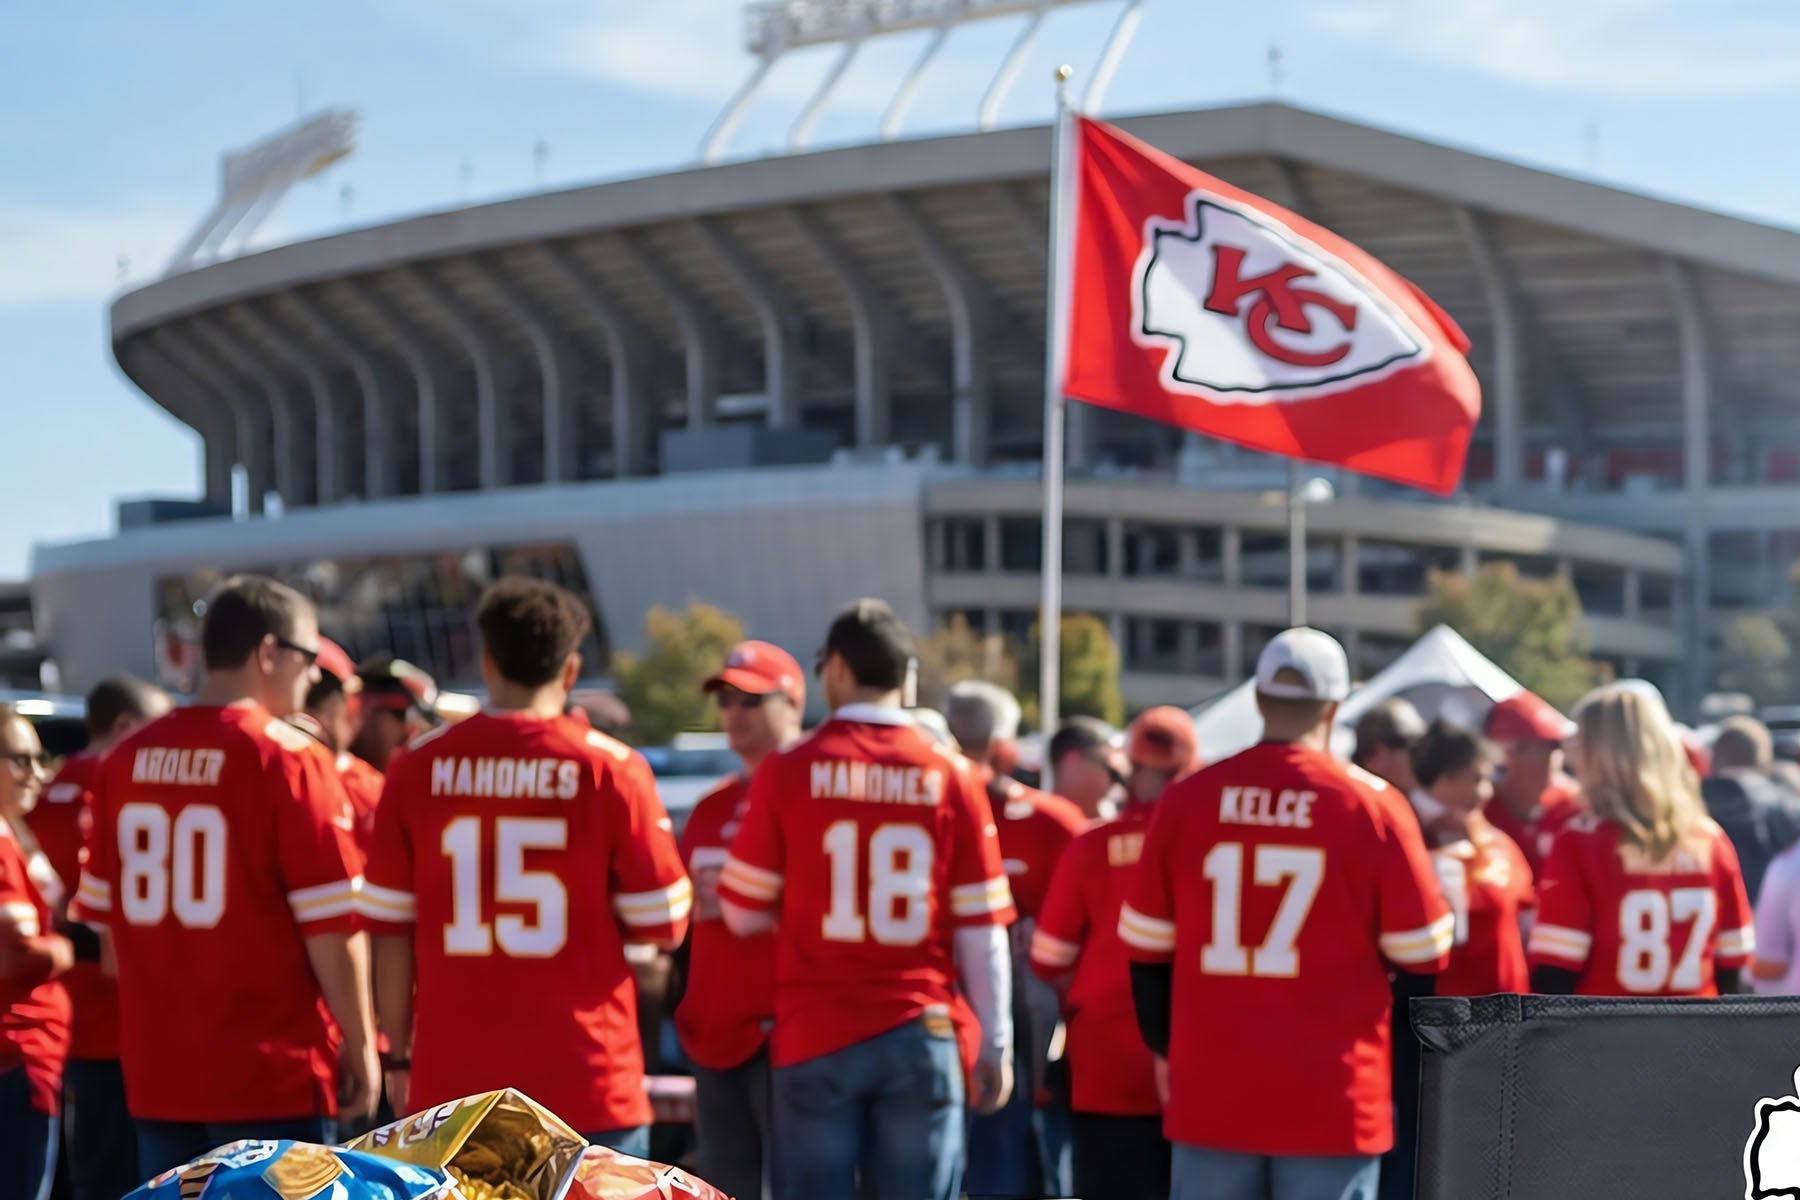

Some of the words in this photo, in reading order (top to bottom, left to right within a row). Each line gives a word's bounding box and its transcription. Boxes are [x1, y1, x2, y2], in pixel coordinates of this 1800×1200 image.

[1204, 244, 1357, 367] KC
[430, 757, 580, 800] MAHOMES
[1218, 785, 1318, 828] KELCE
[117, 802, 228, 929] 80
[440, 815, 569, 959] 15
[822, 819, 935, 946] 18
[1200, 841, 1327, 979] 17
[1616, 887, 1718, 993] 87
